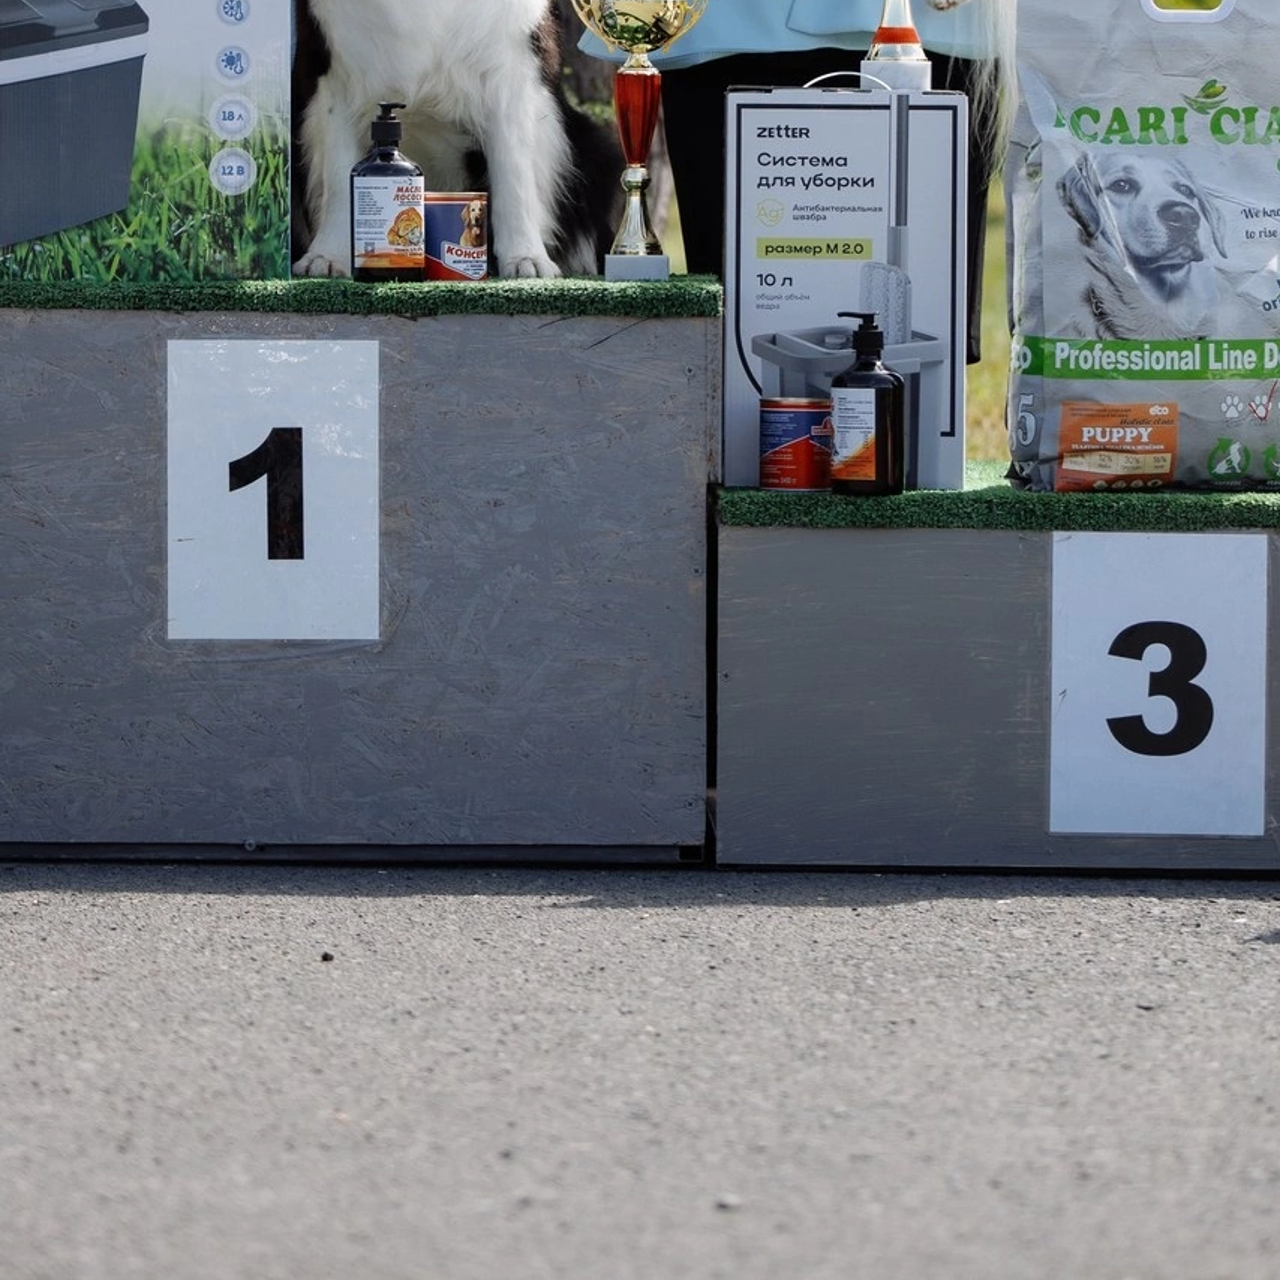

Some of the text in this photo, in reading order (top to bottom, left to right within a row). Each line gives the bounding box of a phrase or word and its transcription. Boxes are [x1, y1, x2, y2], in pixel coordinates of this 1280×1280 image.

[221, 111, 235, 121] 18
[757, 152, 848, 167] Система
[221, 166, 245, 176] 12 В
[757, 173, 875, 191] для уборки
[792, 204, 883, 213] Антибактериальная
[1240, 208, 1261, 219] We
[792, 213, 827, 221] швабра
[1245, 227, 1279, 239] to rise
[765, 244, 822, 256] размер
[841, 243, 864, 254] 2.0
[756, 273, 793, 287] 10 л
[1054, 341, 1201, 370] Professional
[1209, 342, 1257, 370] Line
[1264, 341, 1280, 369] D
[1081, 427, 1153, 442] PUPPY
[229, 427, 304, 560] 1
[1106, 620, 1214, 756] 3
